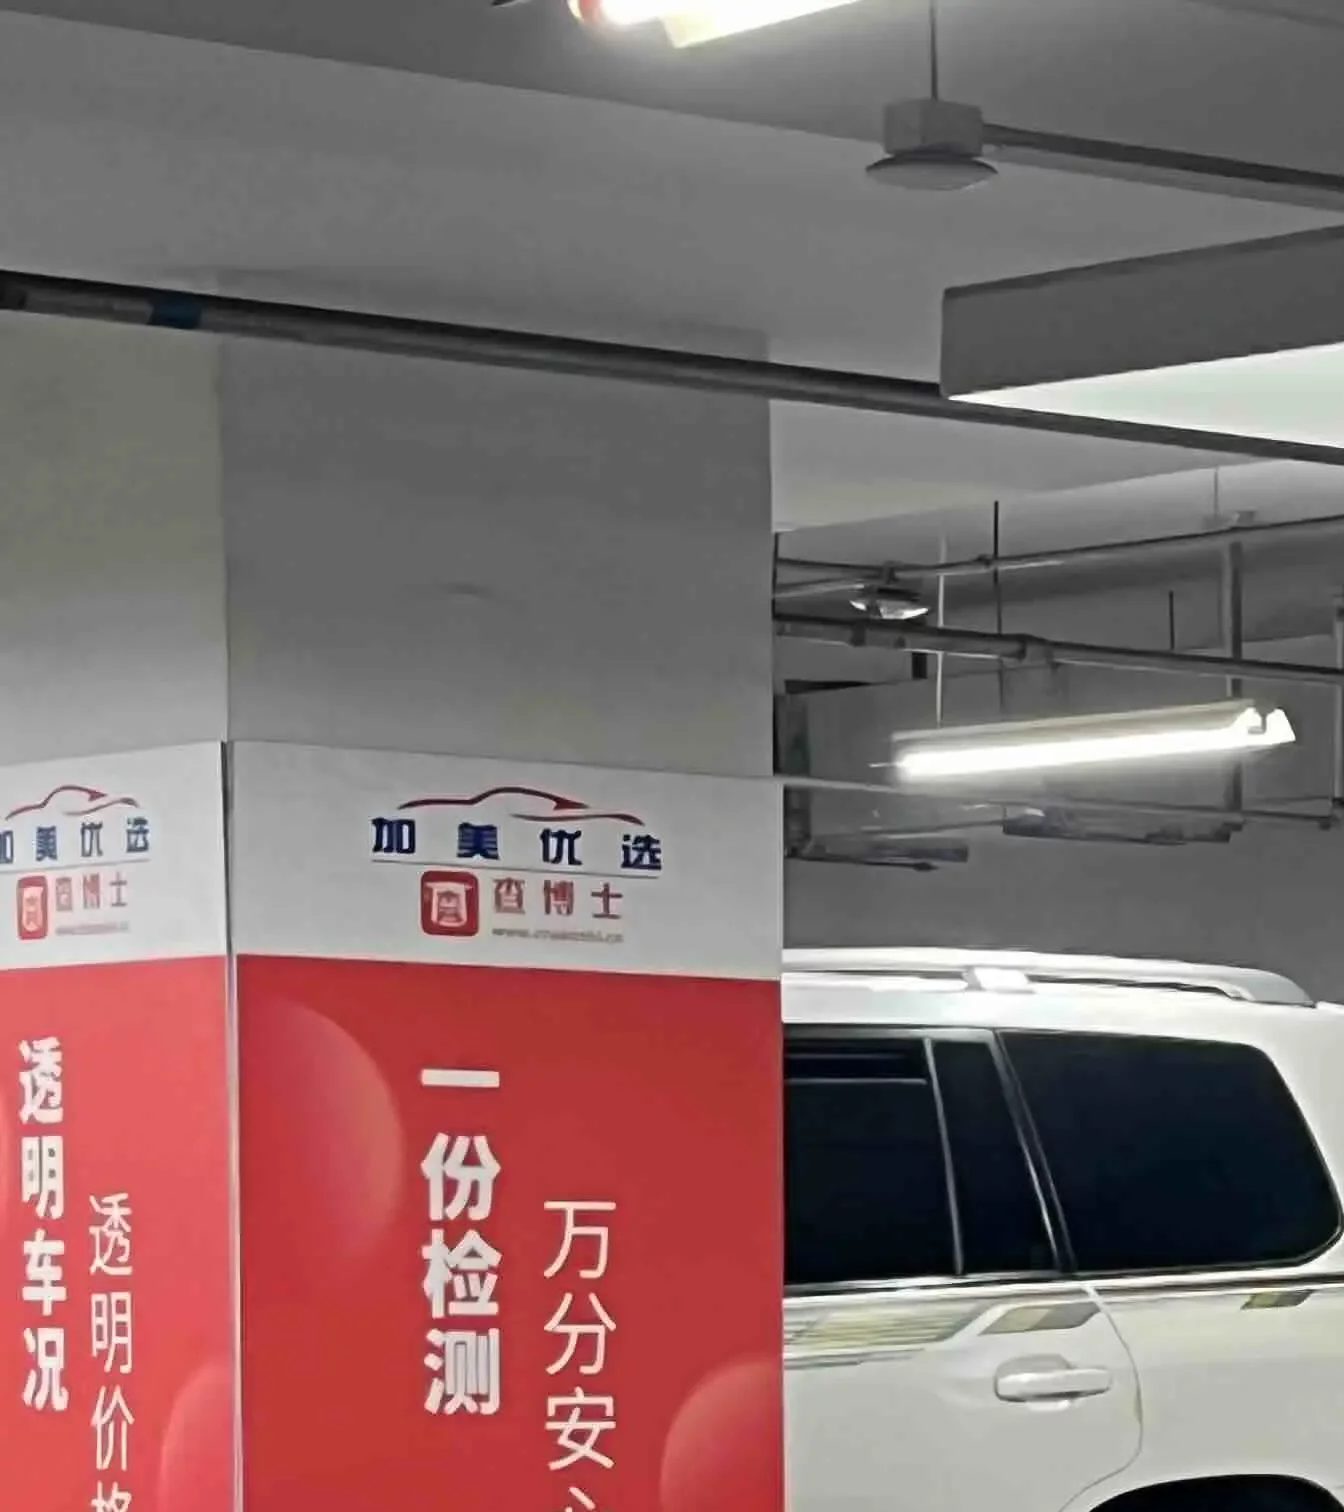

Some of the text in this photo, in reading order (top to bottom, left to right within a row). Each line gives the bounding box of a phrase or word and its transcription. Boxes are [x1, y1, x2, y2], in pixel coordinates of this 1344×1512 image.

[371, 816, 662, 871] 加美优选
[493, 876, 624, 920] 查博士
[18, 1036, 68, 1412] 透明车况
[420, 1068, 501, 1415] 一份检测
